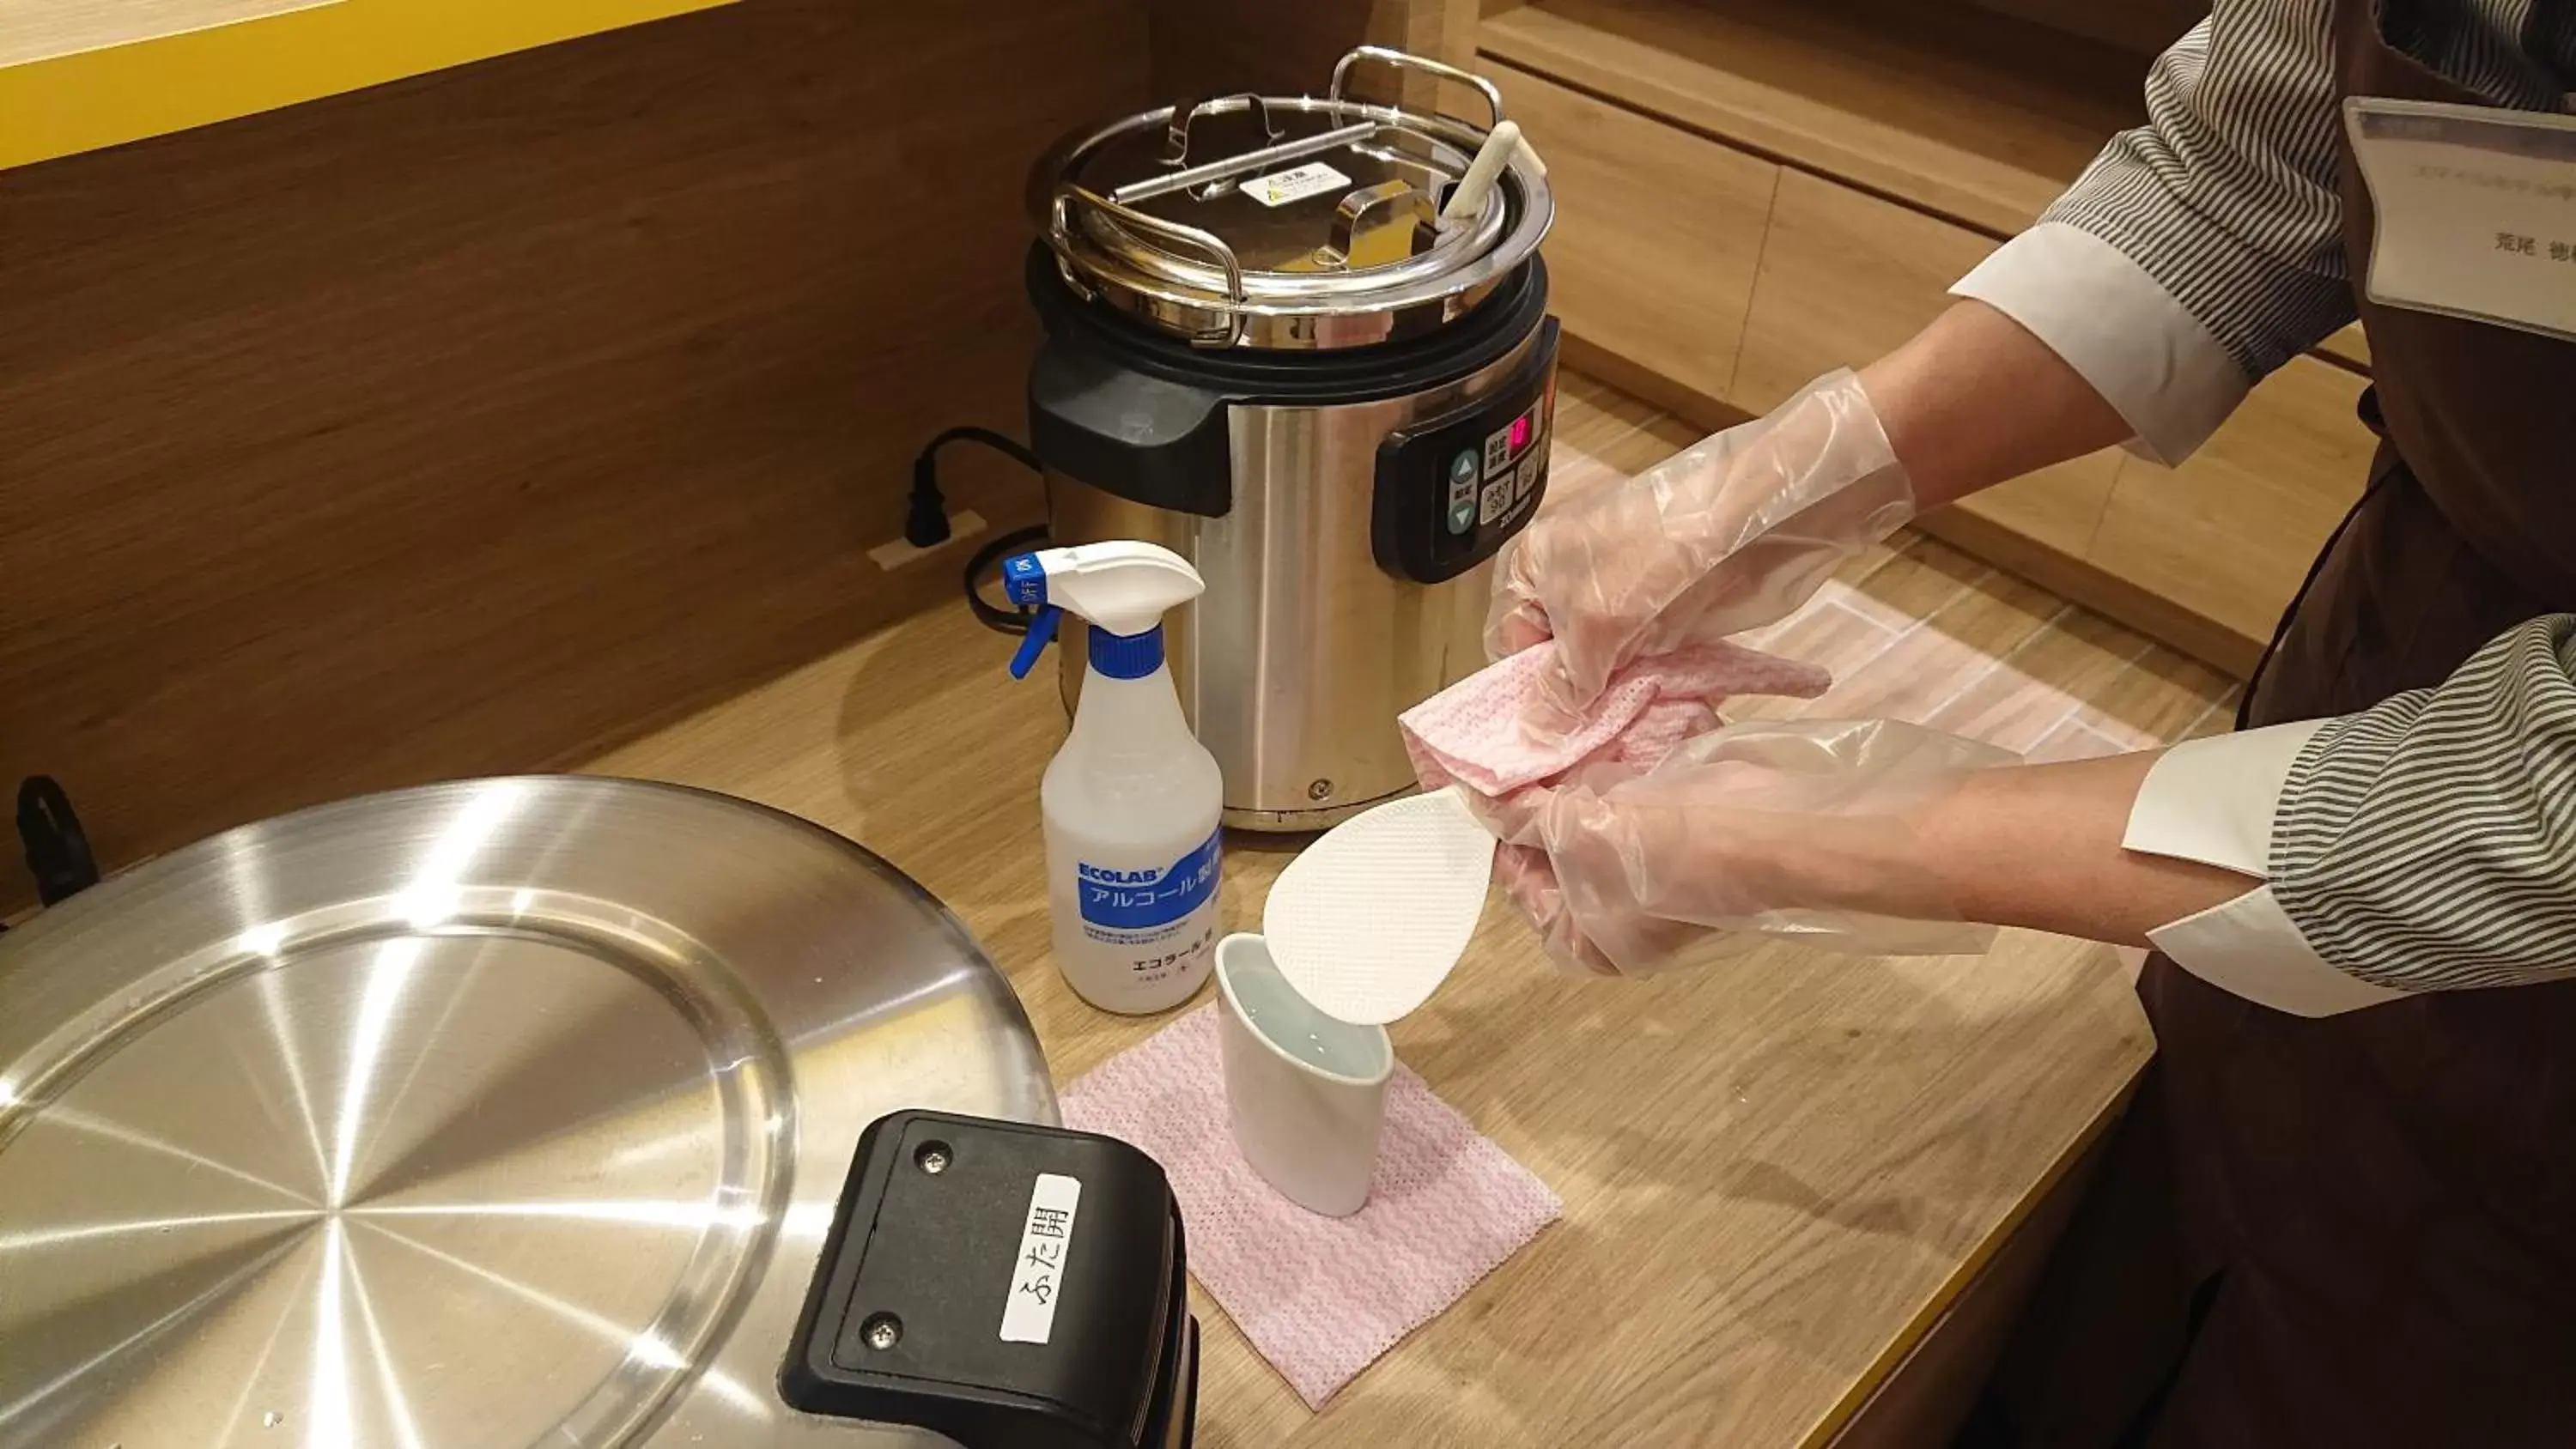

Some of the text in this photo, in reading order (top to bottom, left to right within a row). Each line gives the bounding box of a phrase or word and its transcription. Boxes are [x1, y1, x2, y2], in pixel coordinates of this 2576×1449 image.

[1078, 862, 1157, 883] ECOLAB
[1019, 1206, 1069, 1306] ふた開
